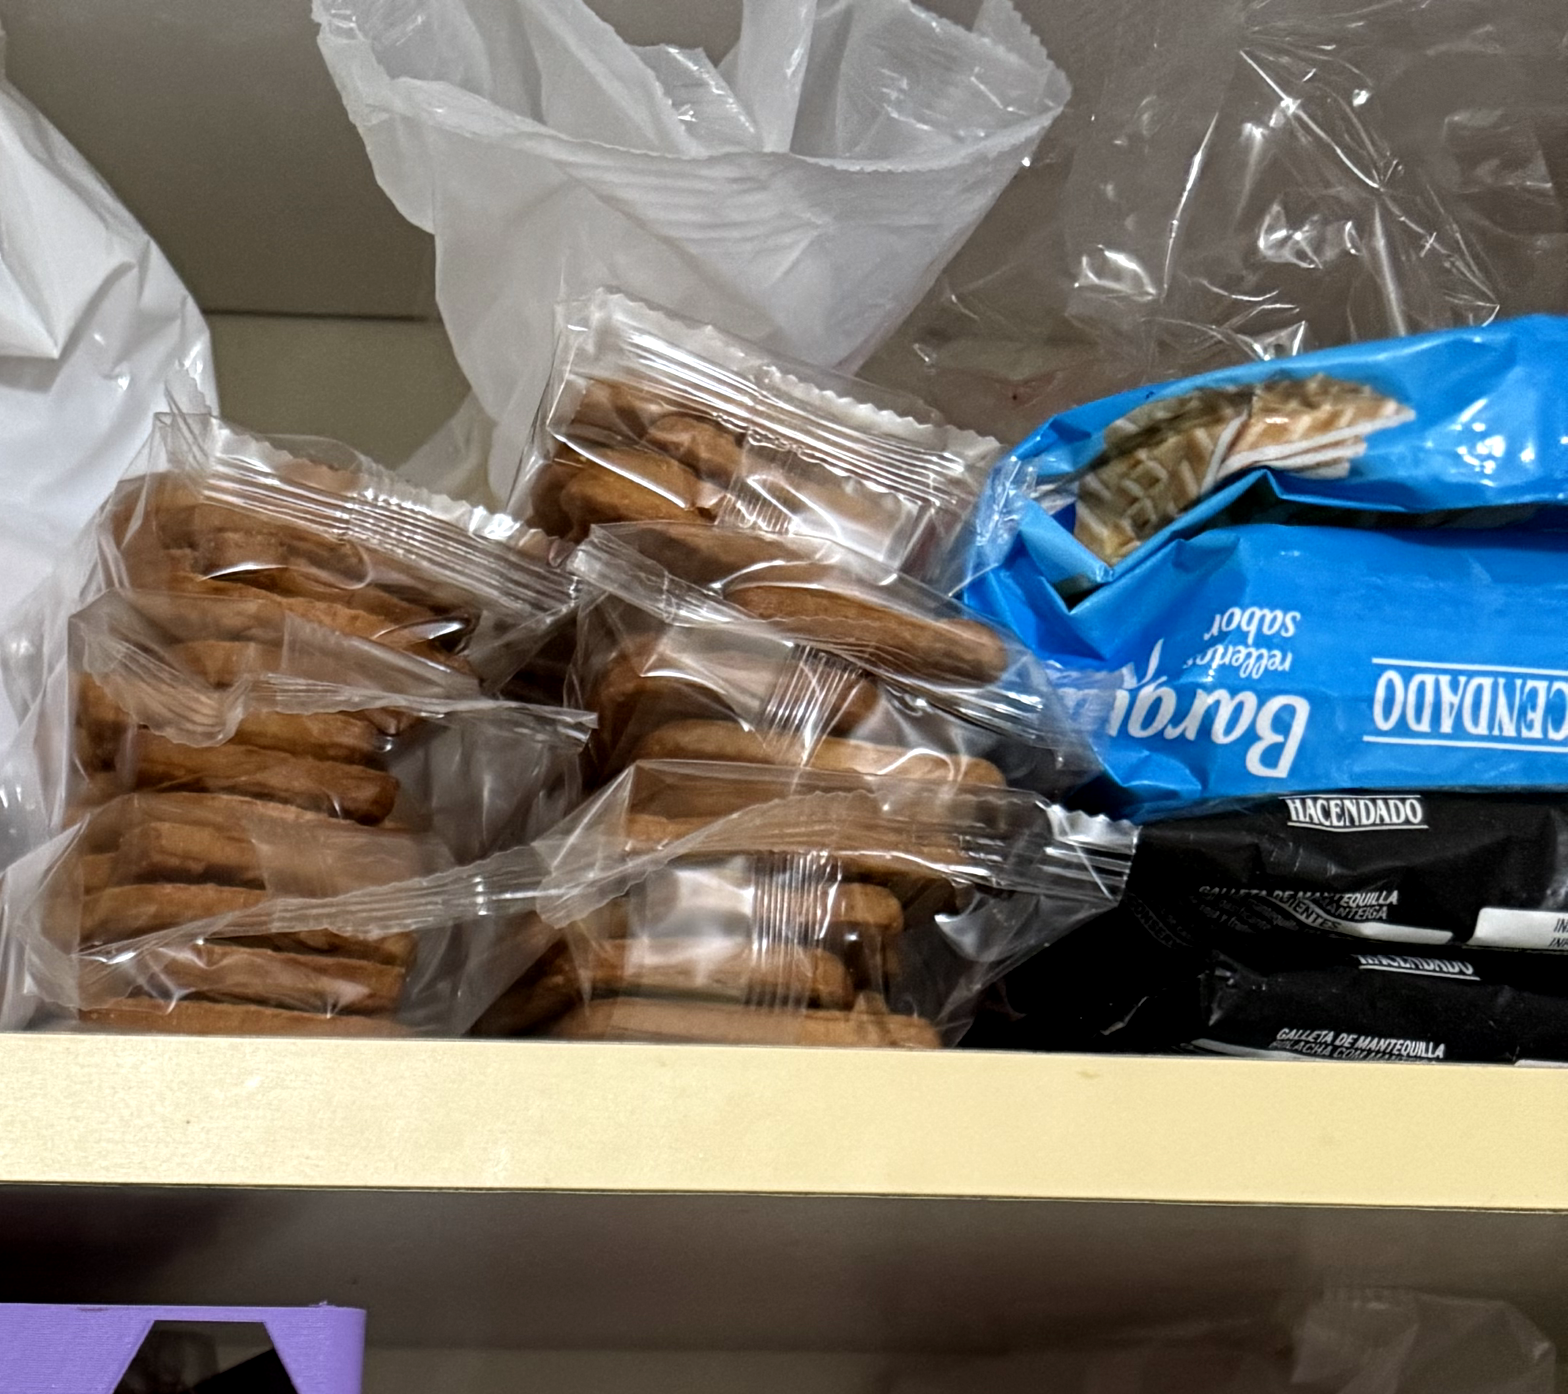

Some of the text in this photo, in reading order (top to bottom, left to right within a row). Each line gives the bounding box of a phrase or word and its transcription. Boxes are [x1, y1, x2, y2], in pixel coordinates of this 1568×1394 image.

[1204, 605, 1301, 645] sabor
[1286, 798, 1424, 828] HACENDADO
[1275, 1026, 1335, 1045] GALLETA
[1335, 1031, 1358, 1047] DE
[1358, 1034, 1448, 1060] MANTEQUILLA
